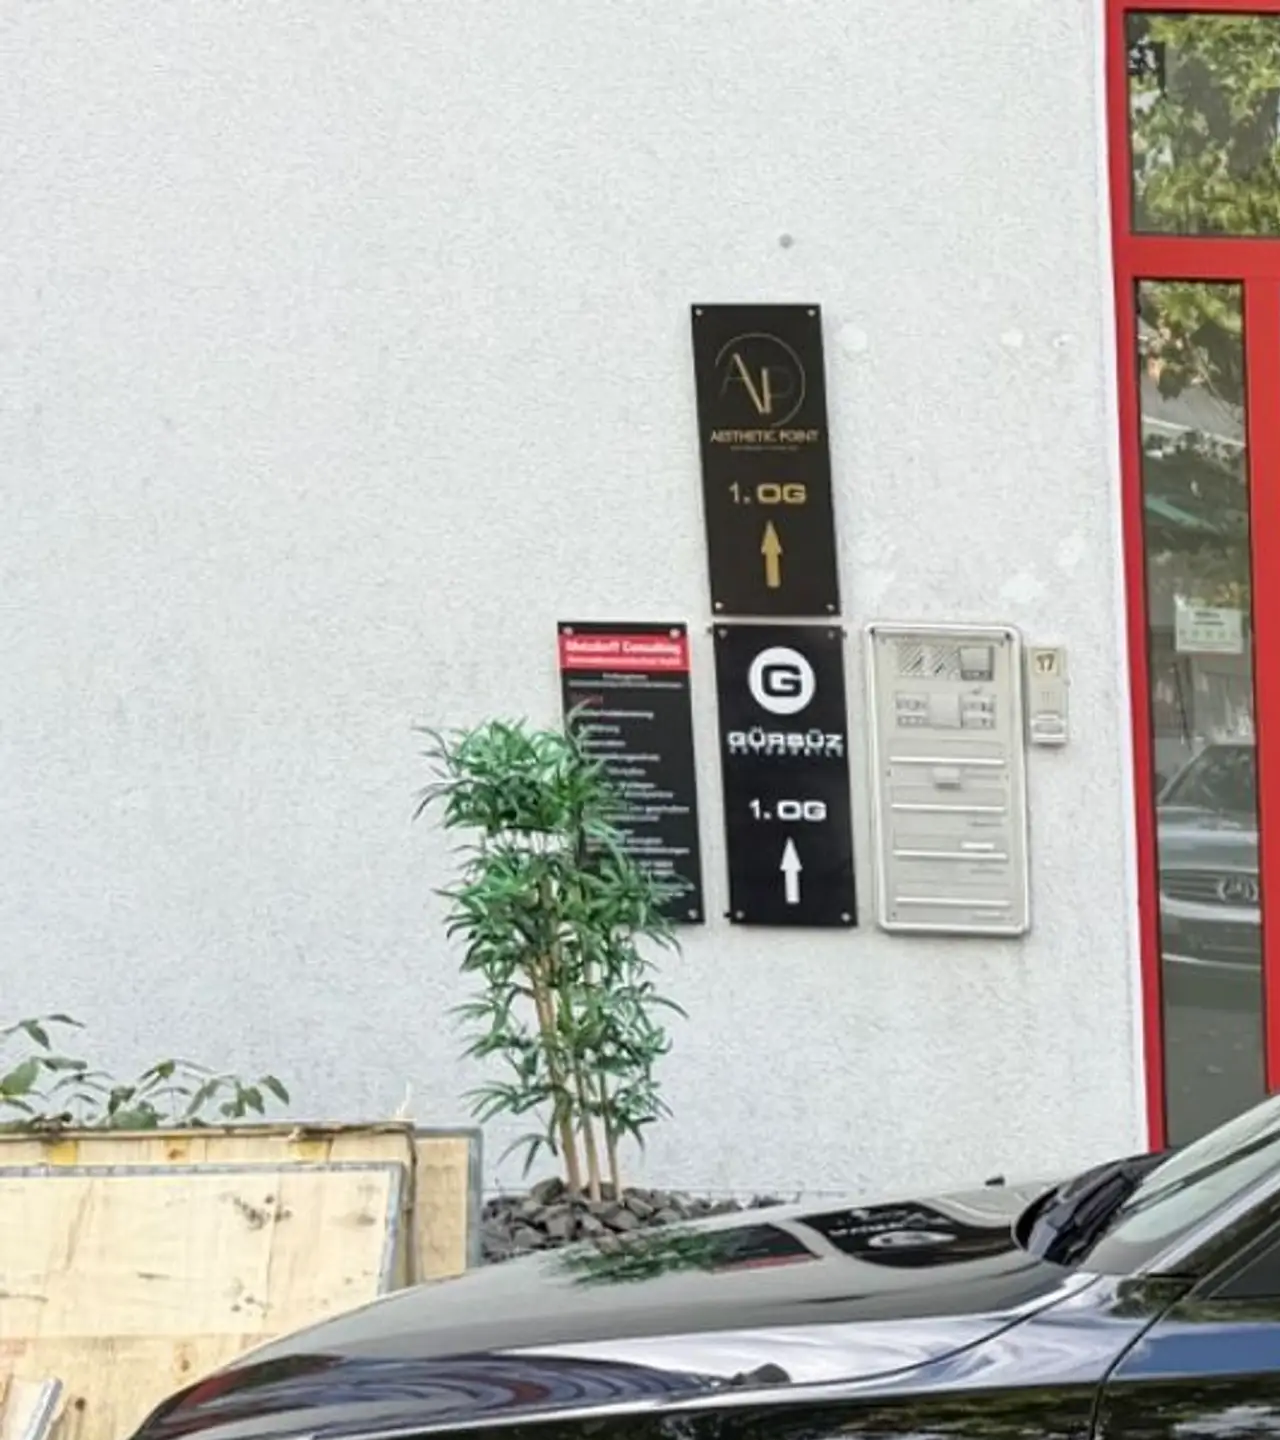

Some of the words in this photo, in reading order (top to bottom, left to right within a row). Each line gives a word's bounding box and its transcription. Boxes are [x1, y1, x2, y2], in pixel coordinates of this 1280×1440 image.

[728, 481, 751, 503] 1.
[757, 482, 807, 504] OG
[761, 664, 803, 698] G
[749, 799, 772, 820] 1.
[777, 800, 827, 821] OG
